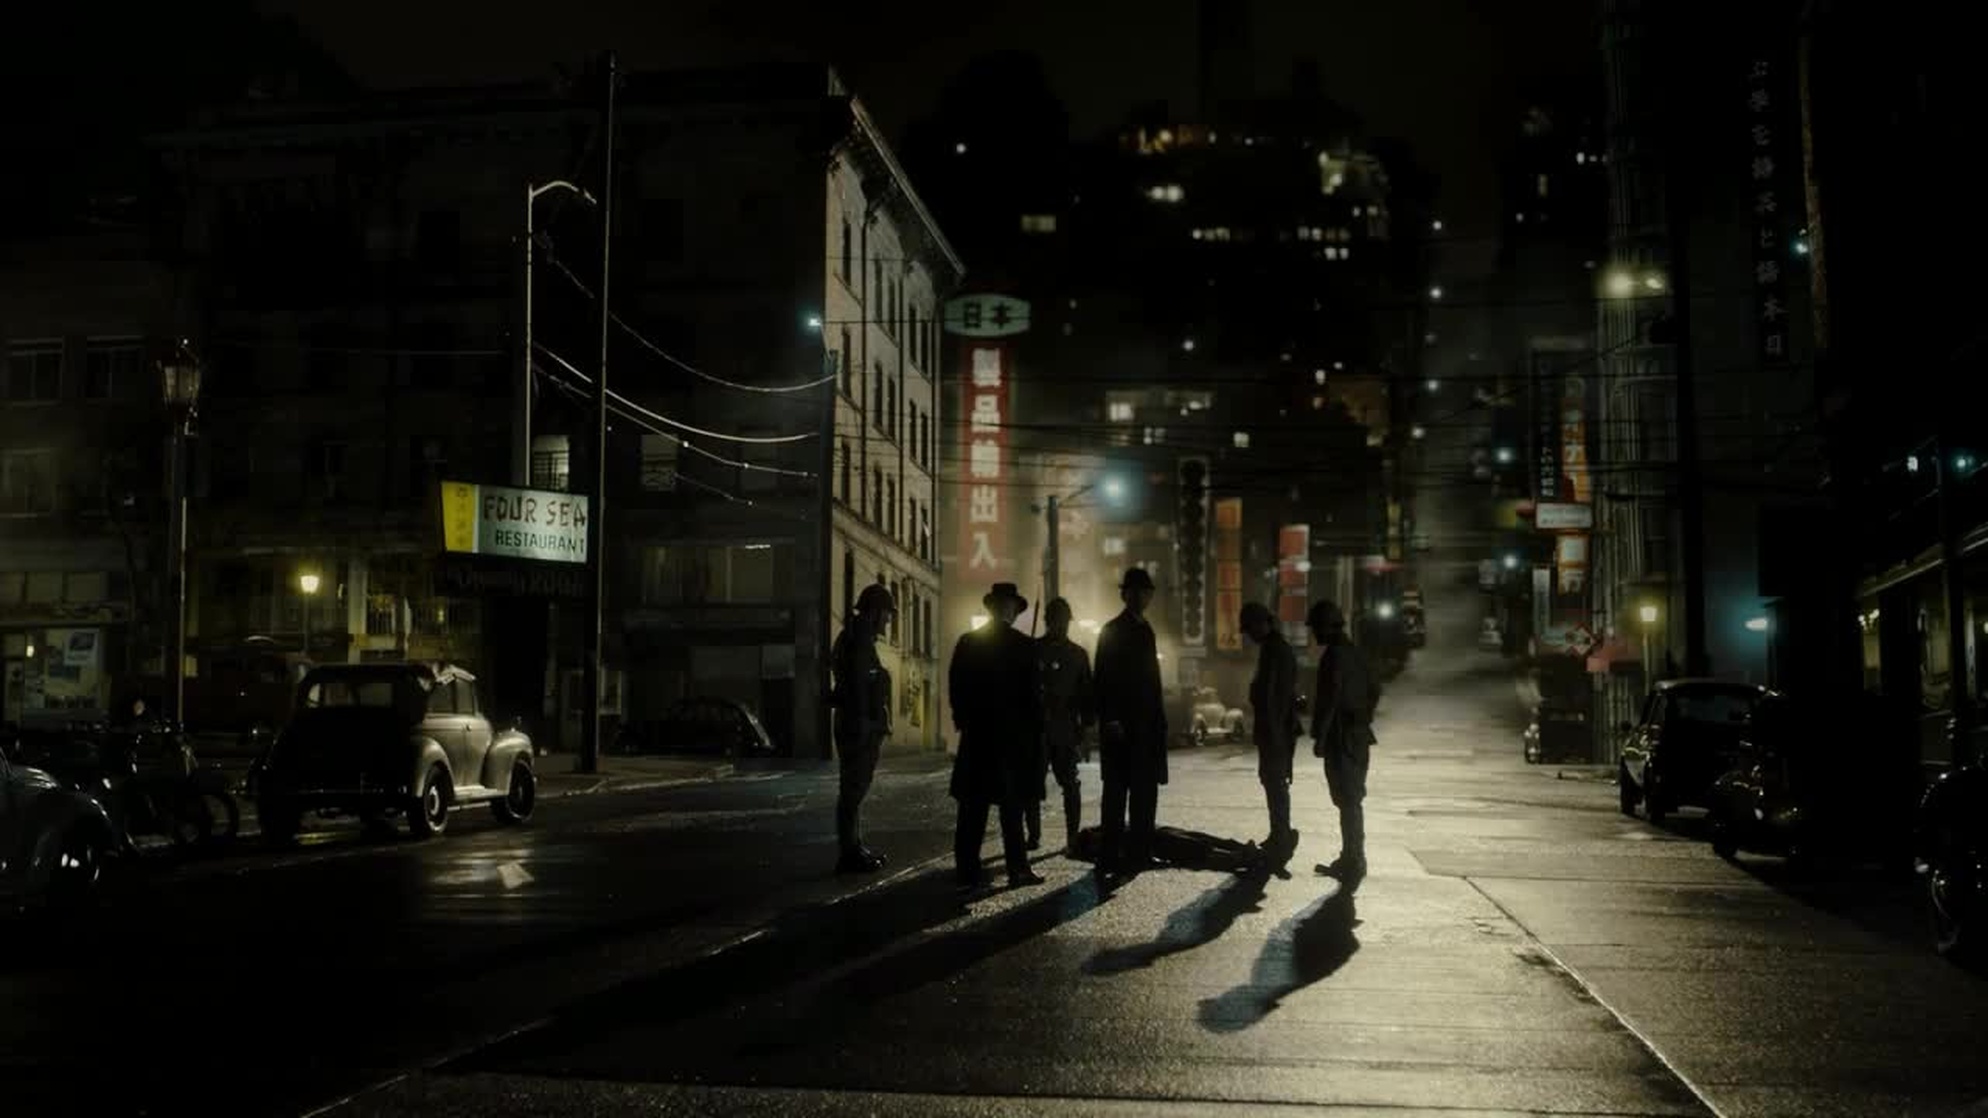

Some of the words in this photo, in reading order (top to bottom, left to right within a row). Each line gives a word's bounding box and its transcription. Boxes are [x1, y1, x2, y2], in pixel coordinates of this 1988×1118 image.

[964, 302, 1011, 329] 日本
[484, 496, 537, 524] FOUR
[495, 529, 585, 554] RESTAURANT
